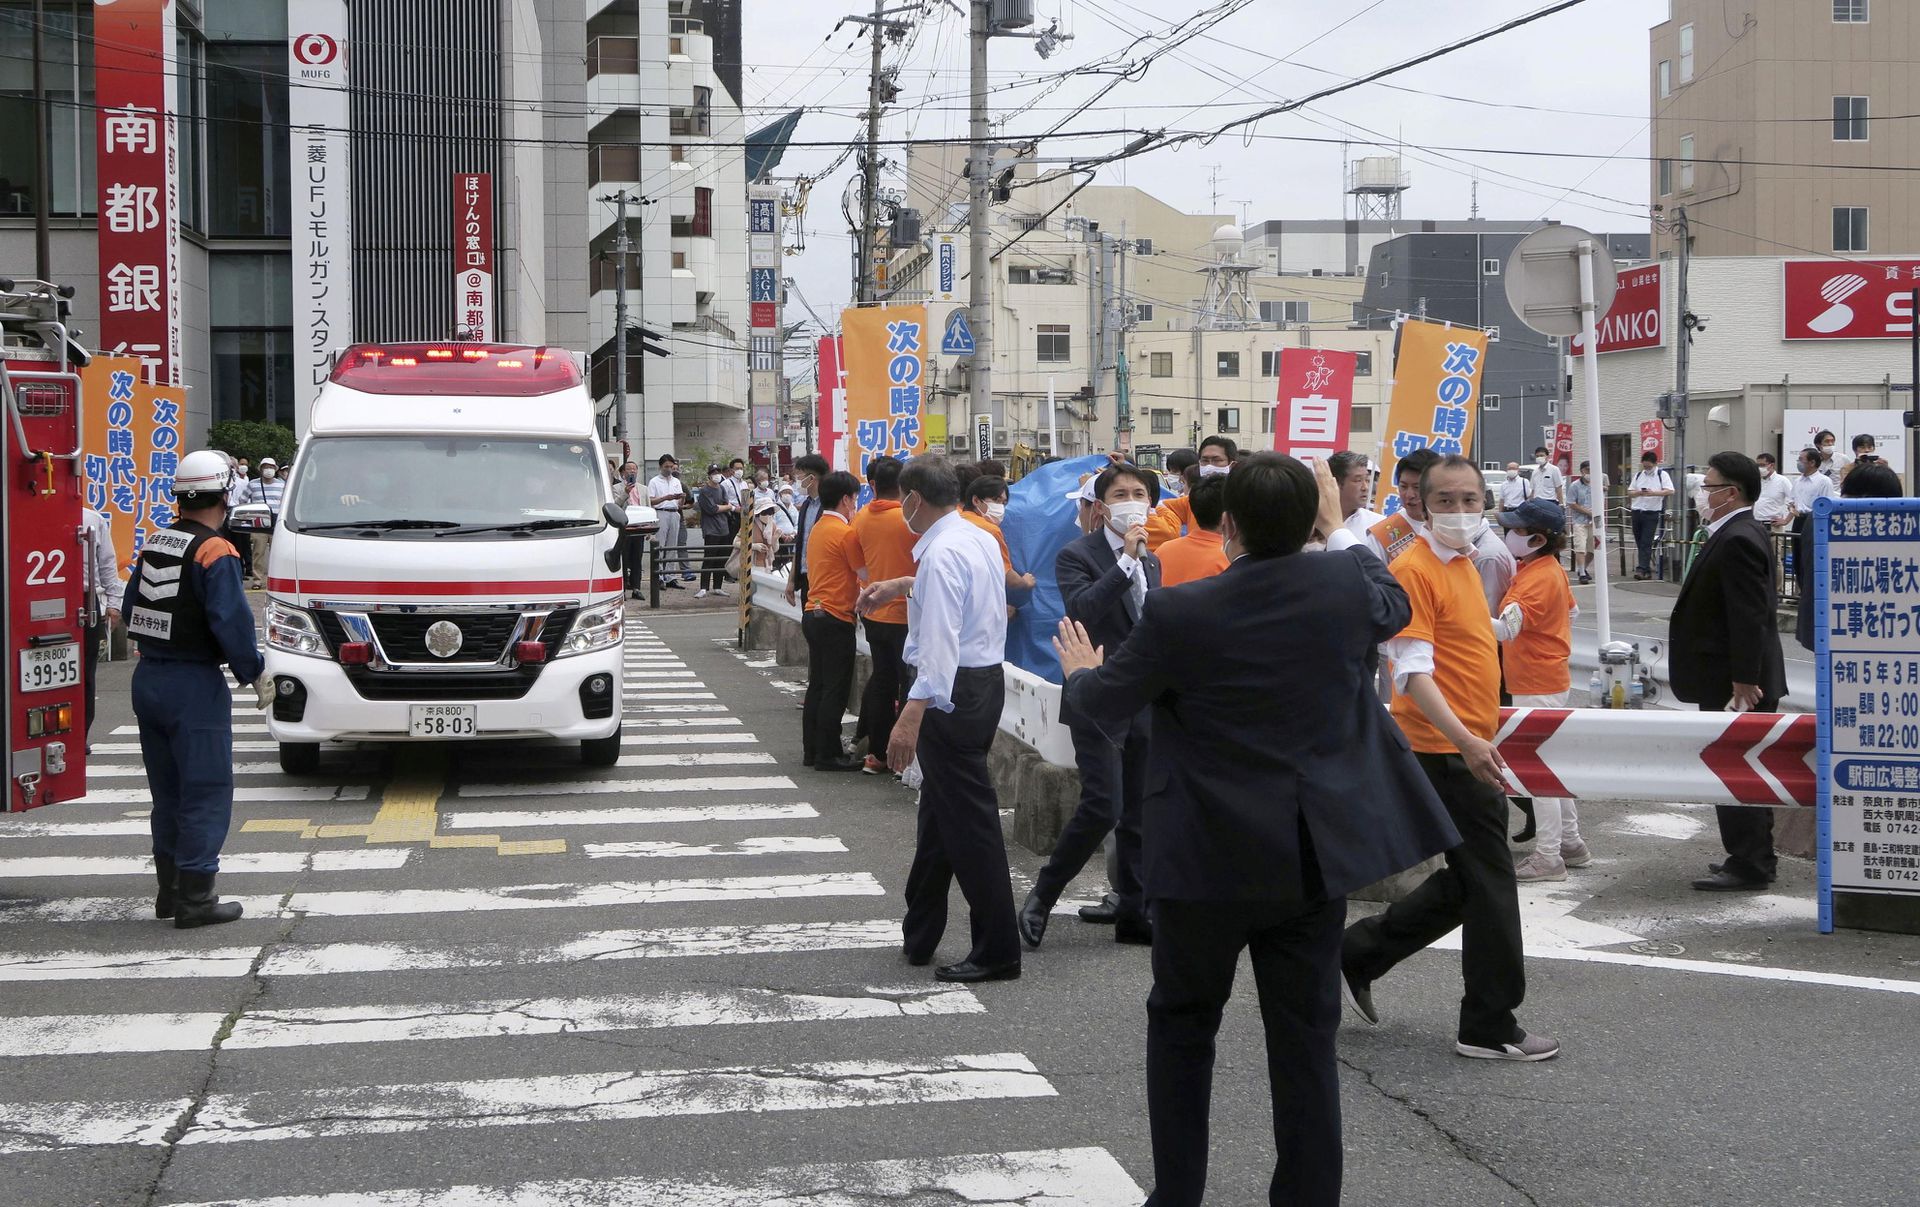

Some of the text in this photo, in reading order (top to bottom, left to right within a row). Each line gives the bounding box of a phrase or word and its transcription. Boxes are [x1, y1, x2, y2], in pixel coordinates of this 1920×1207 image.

[301, 70, 331, 78] MUFG
[465, 177, 480, 265] ほけんの窓口
[761, 269, 771, 301] AGA
[1588, 309, 1658, 346] ANKO
[108, 368, 137, 513] 次の時代を
[150, 397, 180, 529] 次の時代を
[1830, 512, 1920, 536] ご迷惑をおか
[26, 549, 66, 586] 22
[1831, 557, 1920, 594] 駅前広場を大
[34, 647, 67, 662] 奈良800
[33, 660, 77, 686] 99-95
[426, 706, 462, 716] 奈良800
[424, 717, 472, 734] 58-03
[1878, 724, 1918, 749] 22:00
[1848, 764, 1920, 789] 駅前広場整
[1833, 795, 1854, 806] 発注者
[1863, 796, 1893, 808] 奈良市
[1863, 822, 1881, 833] 電話
[1833, 841, 1920, 855] 施工者 鹿島・三和特定建
[1863, 868, 1920, 881] 電話 0742
